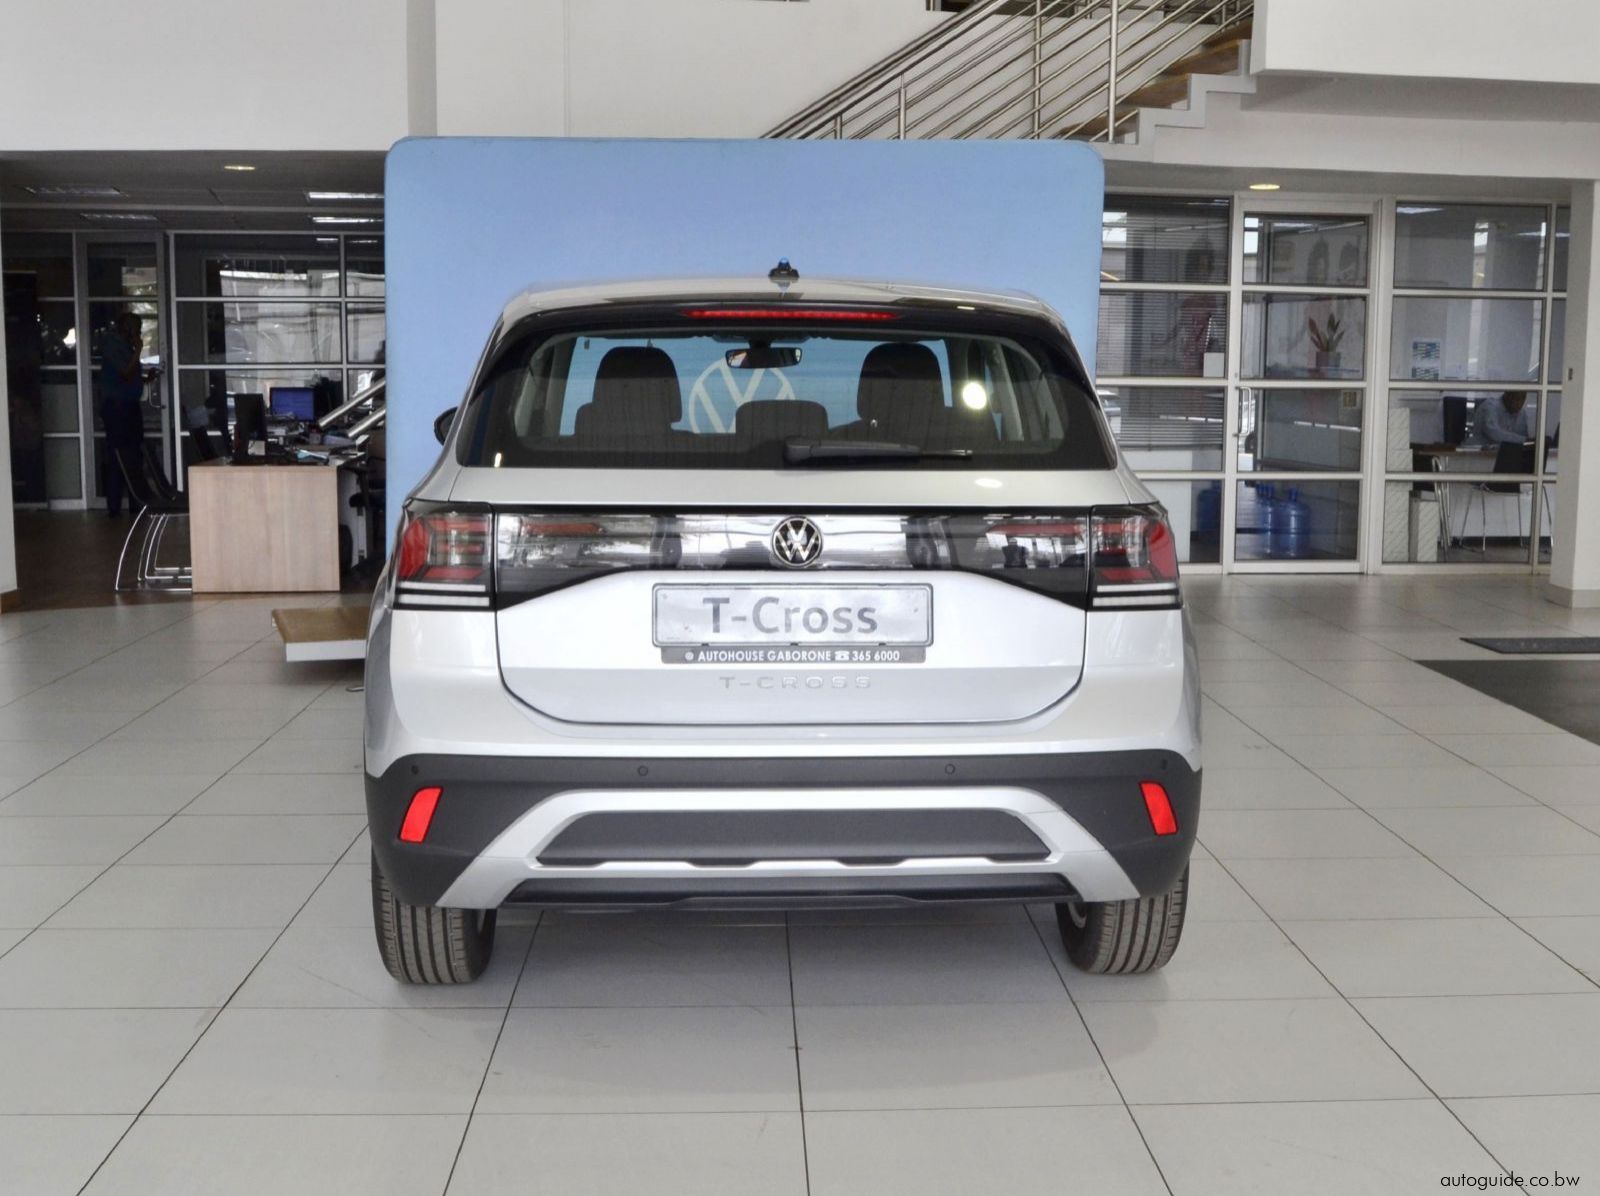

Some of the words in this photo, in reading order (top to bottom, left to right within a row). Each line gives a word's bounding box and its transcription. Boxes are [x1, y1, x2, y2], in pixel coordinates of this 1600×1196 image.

[704, 597, 878, 634] T-Cross
[697, 650, 765, 662] AUTOHOUSE
[767, 650, 831, 662] GABORONE
[852, 650, 872, 661] 365
[874, 650, 900, 661] 6000
[719, 676, 872, 689] T-CROSS
